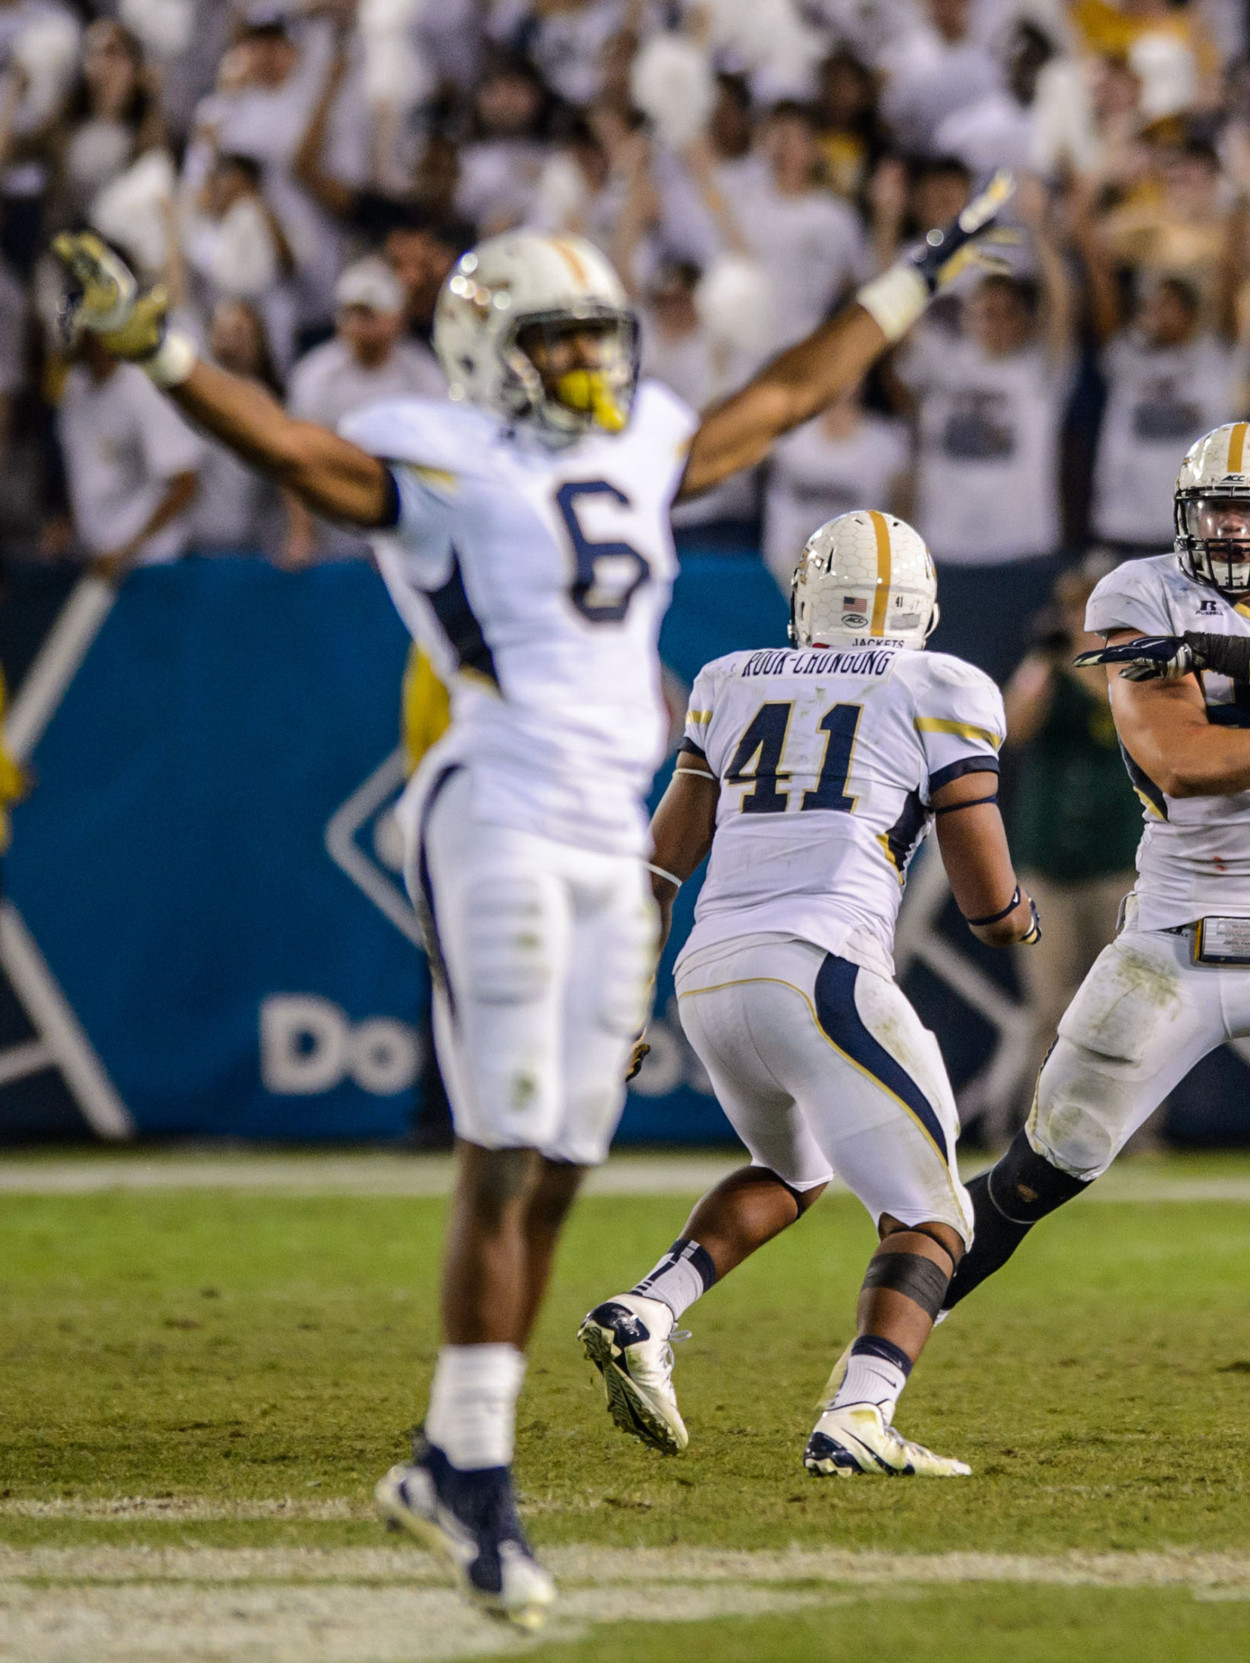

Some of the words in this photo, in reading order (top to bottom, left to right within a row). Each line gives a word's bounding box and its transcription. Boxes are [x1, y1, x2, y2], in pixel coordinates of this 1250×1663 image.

[557, 481, 650, 623] 6
[895, 596, 903, 608] 41
[1200, 600, 1218, 611] R
[852, 638, 904, 648] JACKETS
[723, 700, 865, 814] 41
